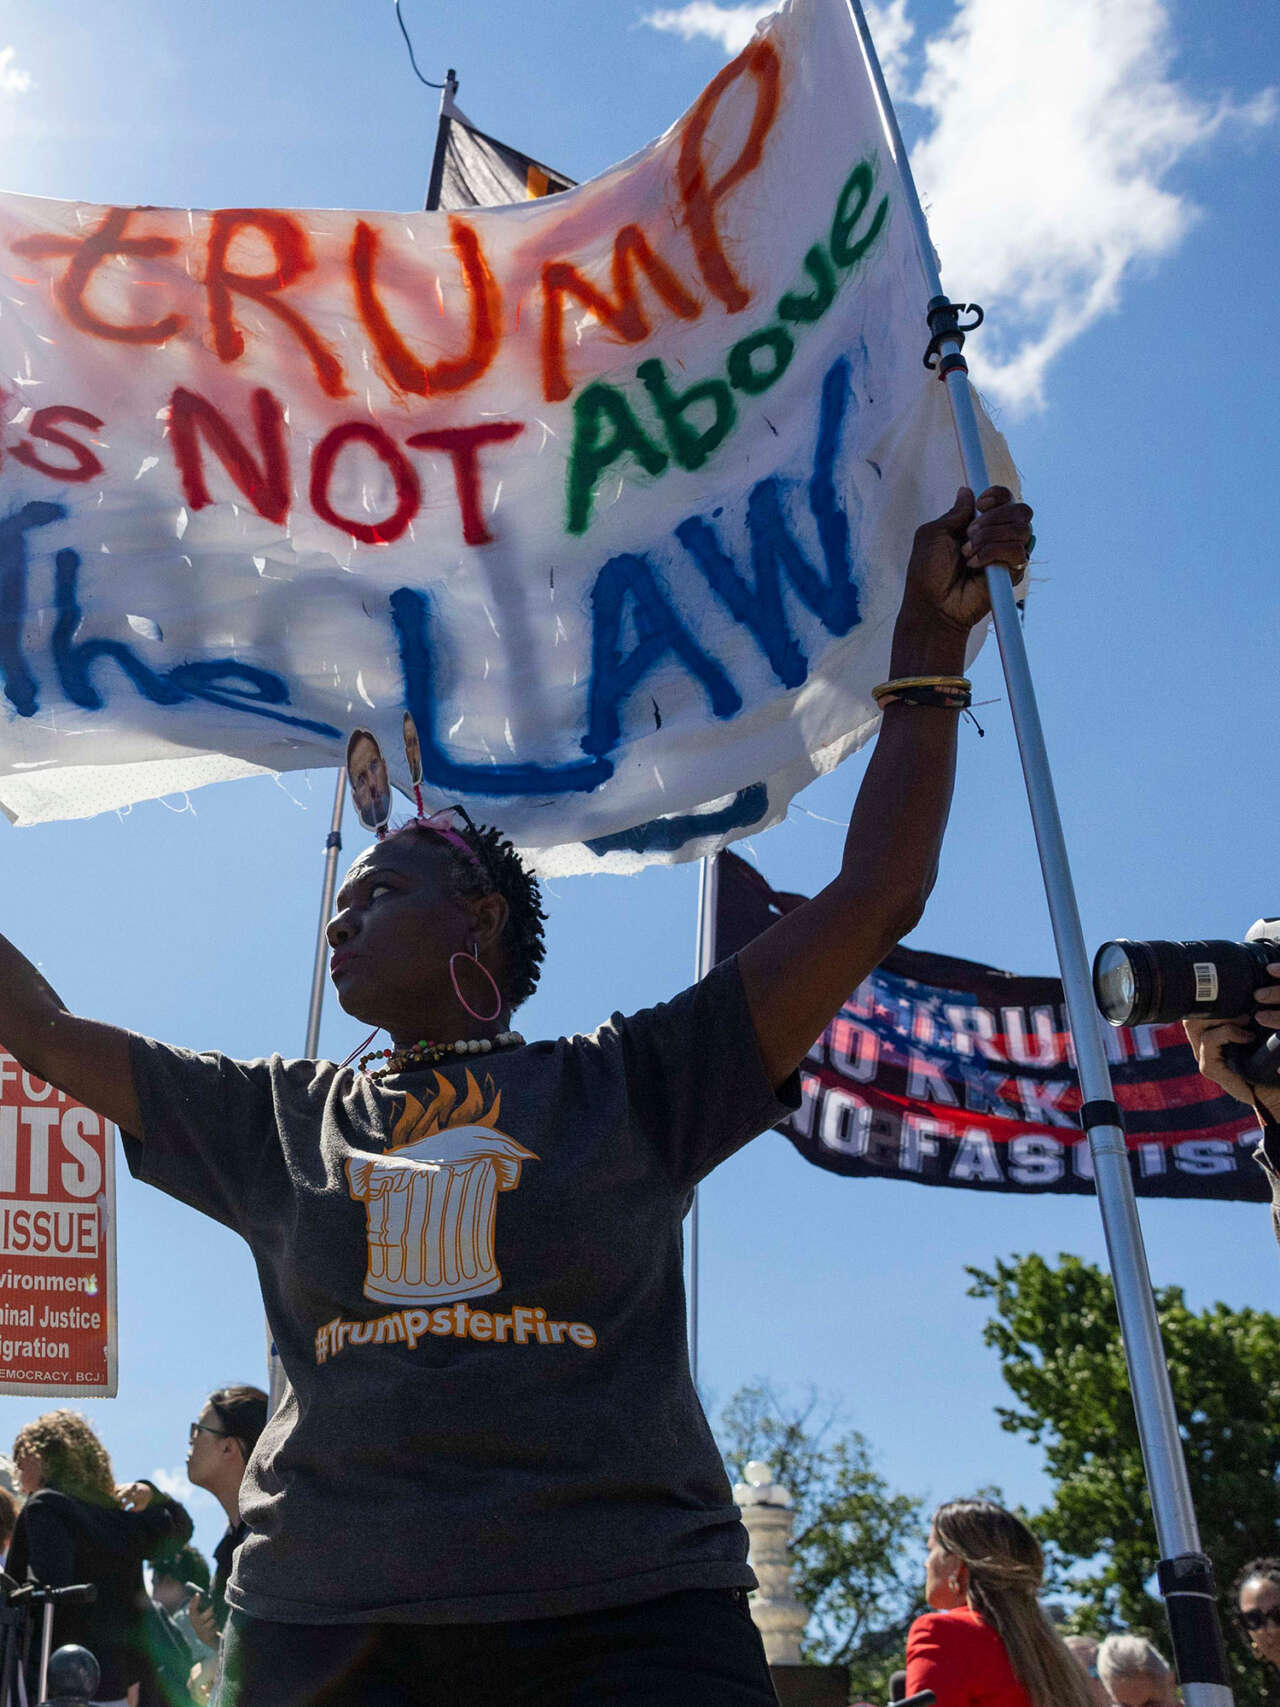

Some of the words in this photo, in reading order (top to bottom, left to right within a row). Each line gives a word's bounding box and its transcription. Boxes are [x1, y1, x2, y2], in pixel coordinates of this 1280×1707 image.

[168, 386, 525, 546] NOT
[565, 162, 889, 536] Above
[388, 356, 861, 795] LAW
[905, 1049, 1081, 1128] KKK
[3, 1209, 97, 1254] ISSUE
[39, 1305, 101, 1330] Justice
[315, 1303, 597, 1365] #TrumpsterFire
